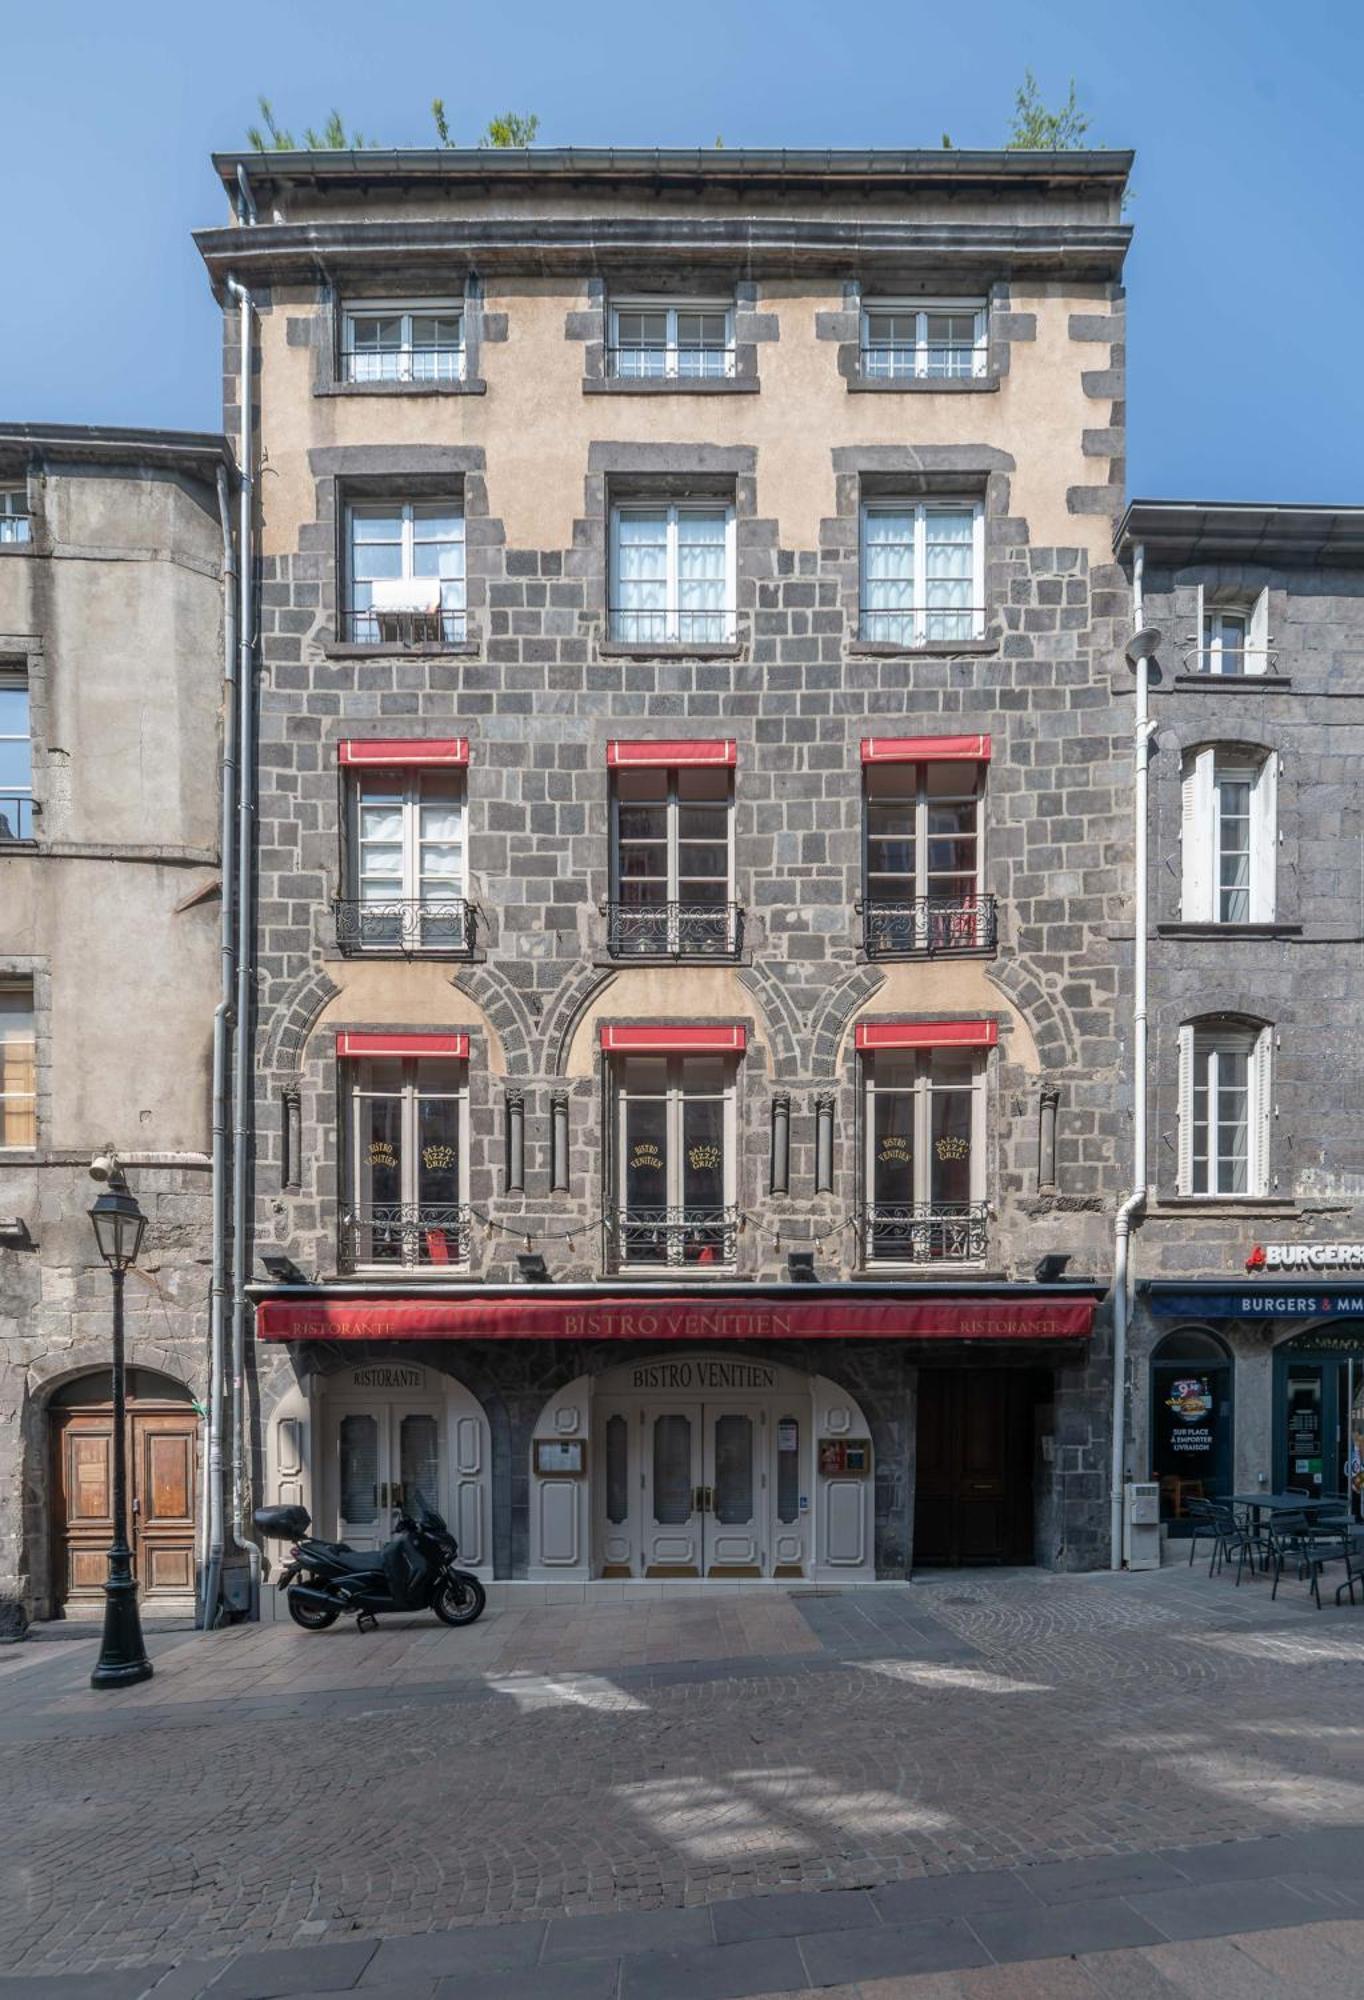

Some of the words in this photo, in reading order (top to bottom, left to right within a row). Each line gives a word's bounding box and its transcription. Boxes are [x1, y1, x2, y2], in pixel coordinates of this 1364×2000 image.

[1241, 1298, 1317, 1312] BURGERS
[292, 1322, 395, 1335] RISTORANTE
[564, 1314, 658, 1335] BISTRO
[665, 1314, 792, 1334] VENITIEN
[960, 1320, 1060, 1333] RISTORANTE
[353, 1367, 420, 1387] RISTORANTE
[633, 1362, 692, 1388] BISTRO
[698, 1362, 774, 1388] VENITIEN
